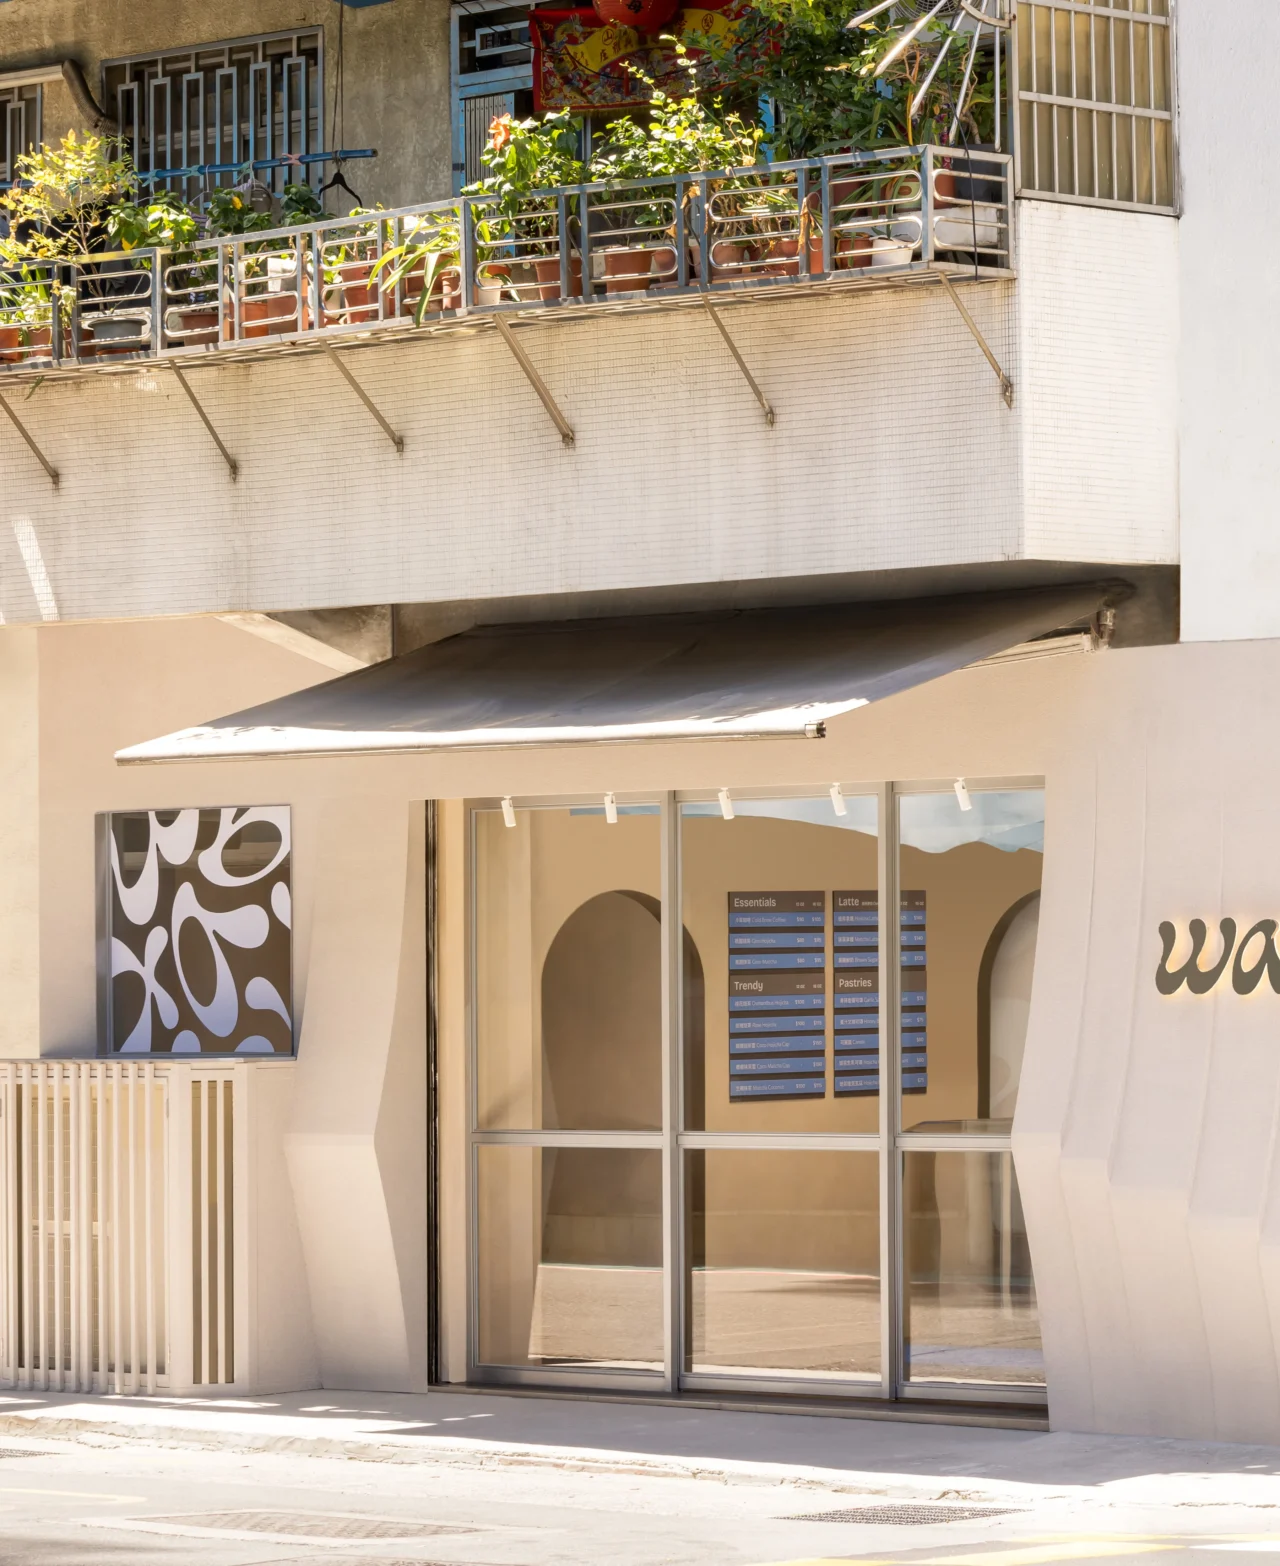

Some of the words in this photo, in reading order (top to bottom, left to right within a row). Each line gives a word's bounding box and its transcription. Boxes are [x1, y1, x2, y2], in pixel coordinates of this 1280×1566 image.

[734, 897, 776, 907] Essentials
[838, 897, 859, 906] Latte
[734, 980, 763, 992] Trendy
[839, 977, 872, 988] Pastries
